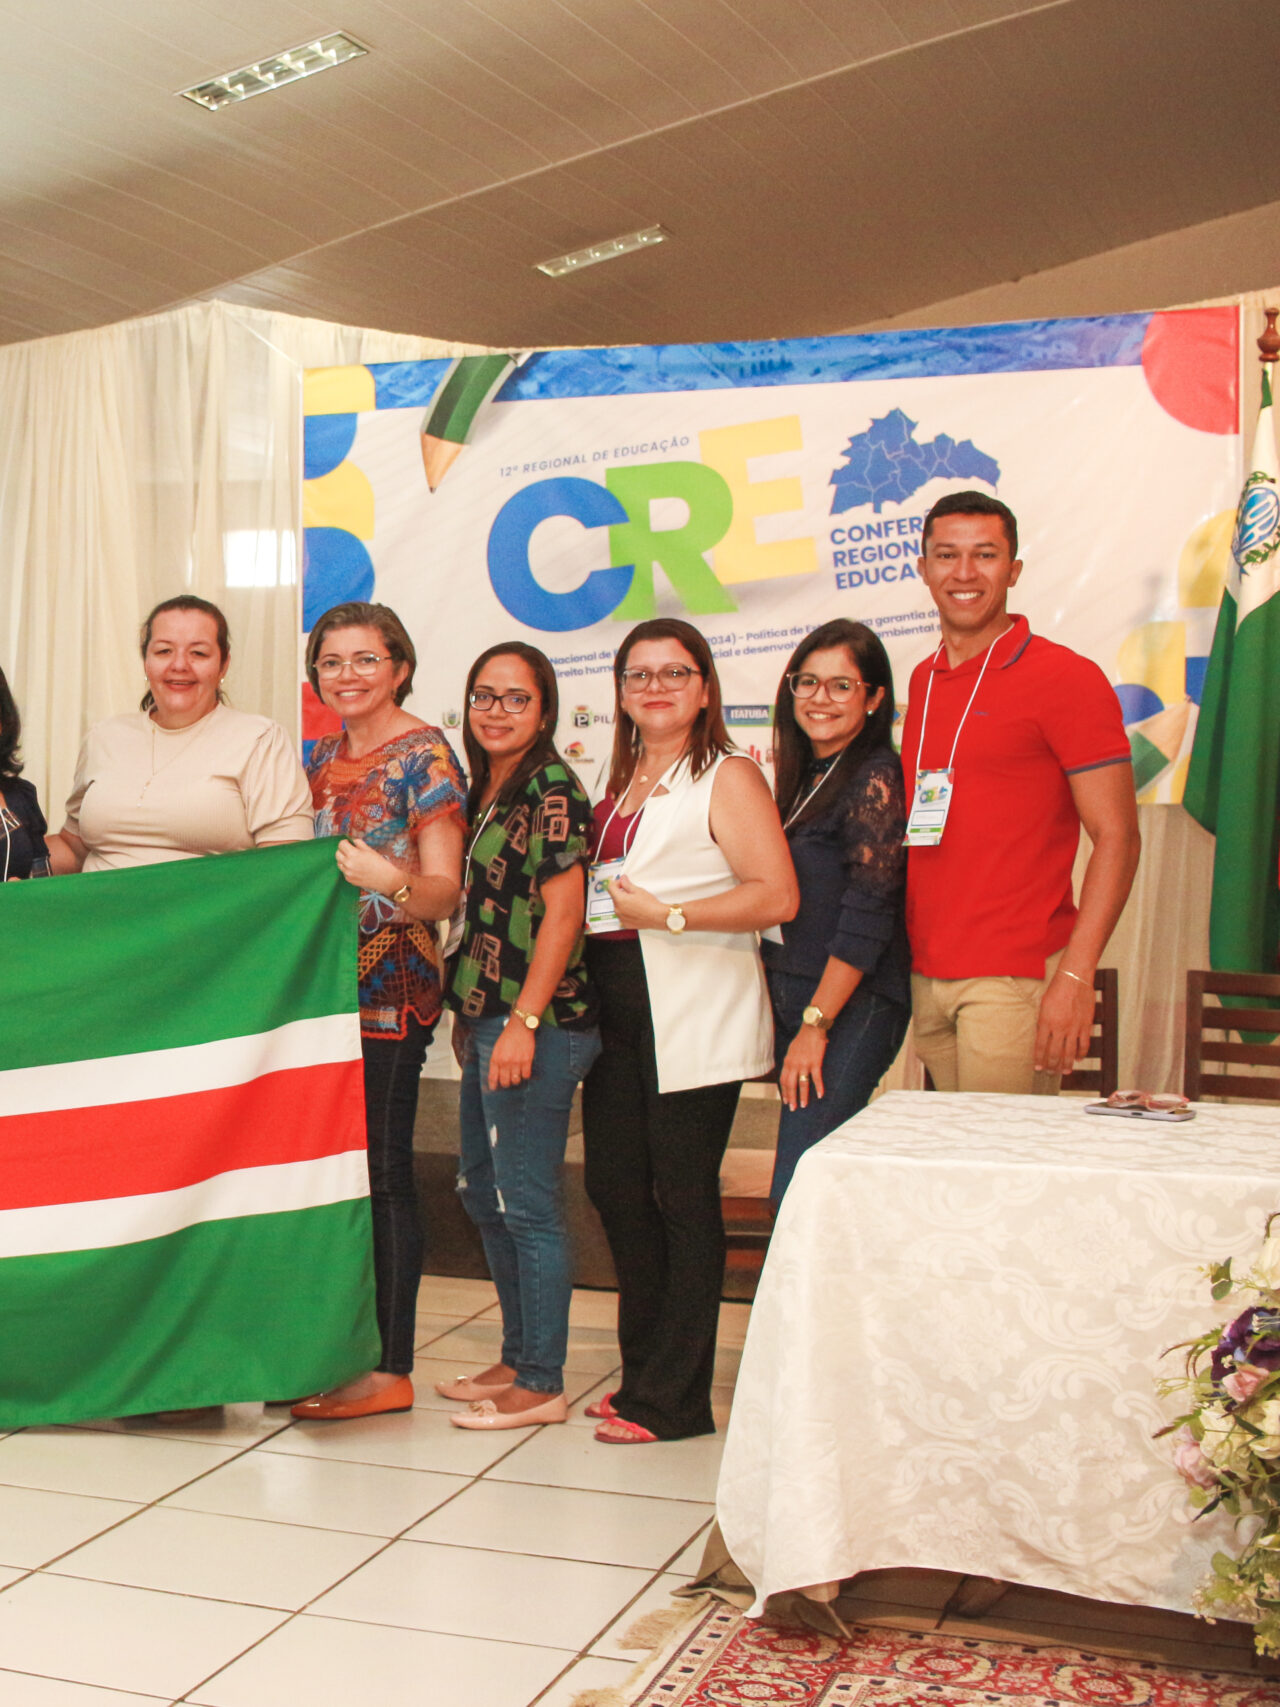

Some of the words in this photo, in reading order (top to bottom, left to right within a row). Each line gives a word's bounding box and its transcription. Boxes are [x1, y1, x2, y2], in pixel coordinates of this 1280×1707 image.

[523, 456, 587, 473] REGIONAL
[592, 450, 609, 462] DE
[614, 436, 690, 458] EDUCAÇÃO
[487, 414, 819, 632] CRE
[830, 511, 928, 545] CONFER
[833, 539, 920, 568] REGION
[836, 563, 916, 590] EDUCA
[875, 610, 926, 628] garantia
[746, 628, 788, 641] Política
[790, 626, 804, 636] de
[599, 650, 611, 659] de
[712, 648, 732, 659] cial
[735, 649, 741, 657] e
[730, 709, 769, 719] ITATUBA
